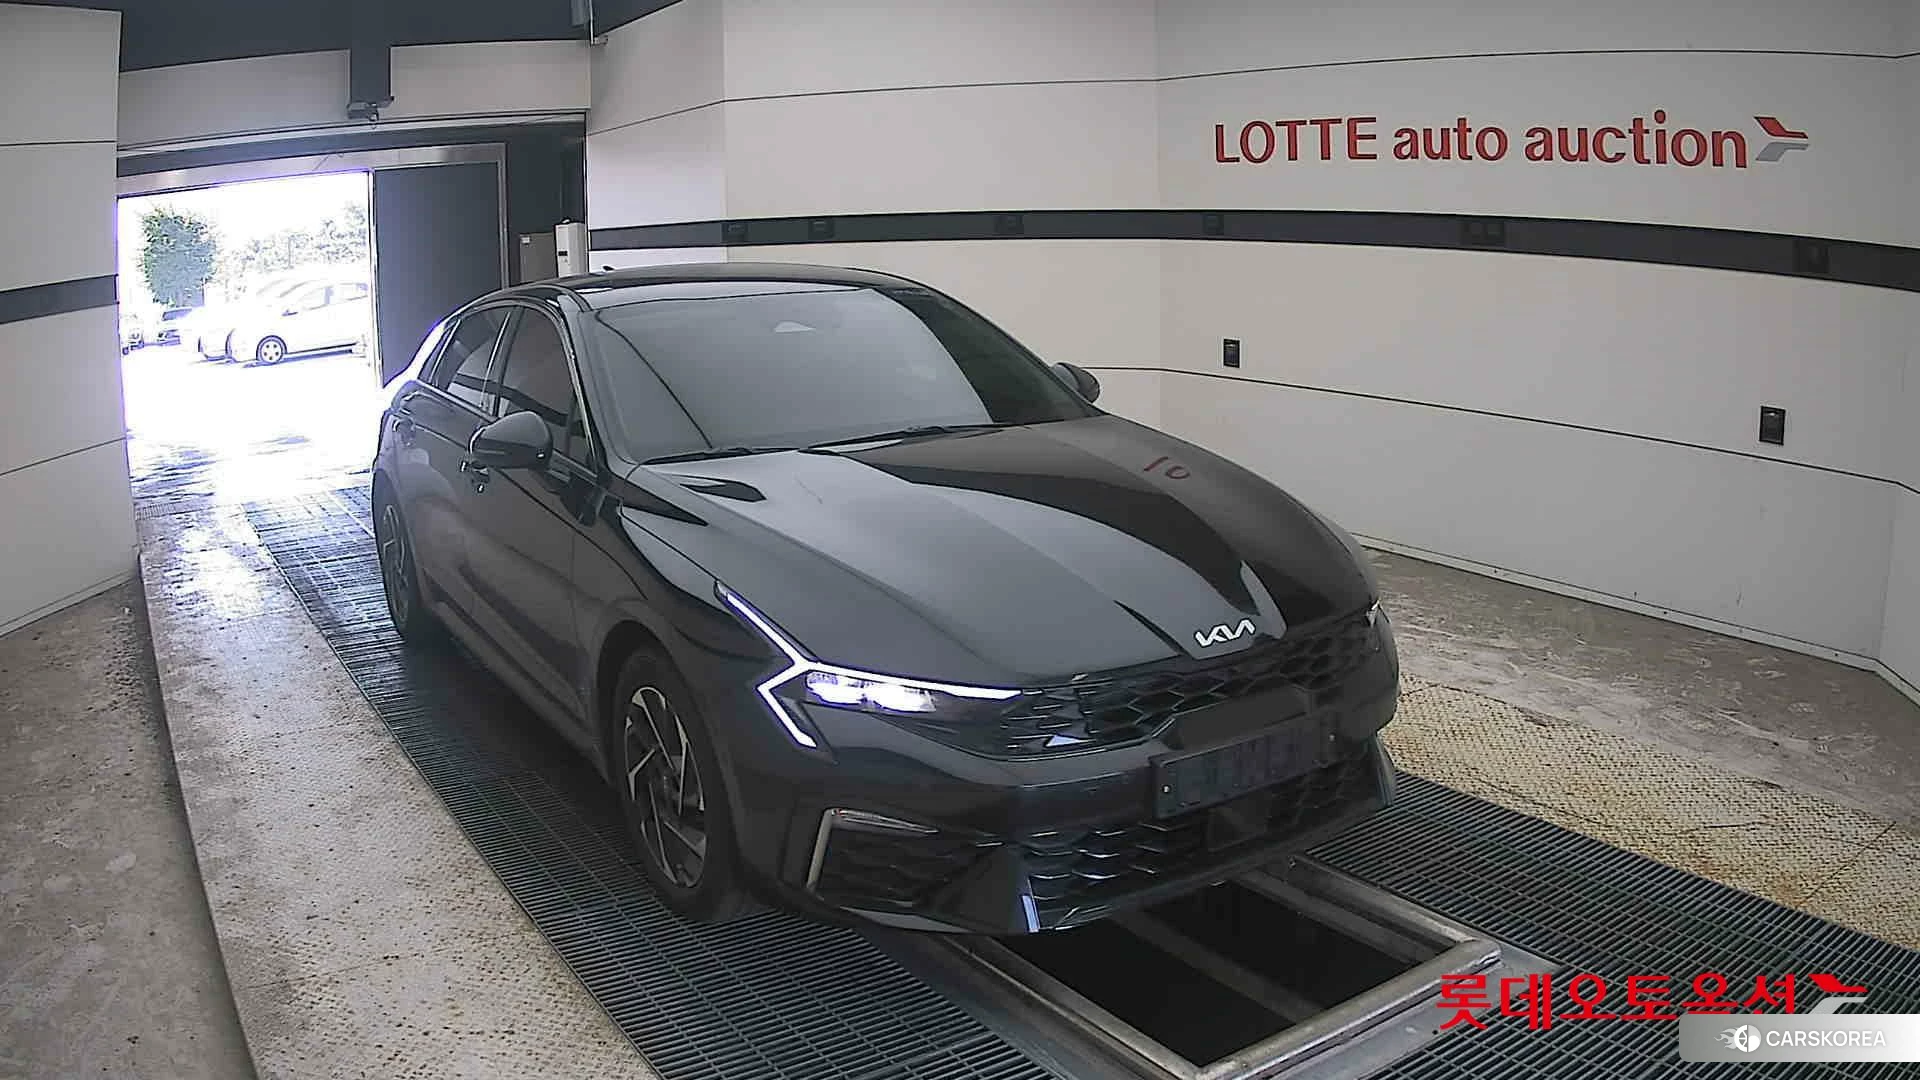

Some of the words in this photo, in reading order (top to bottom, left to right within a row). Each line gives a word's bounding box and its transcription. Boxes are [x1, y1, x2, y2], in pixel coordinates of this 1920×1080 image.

[1215, 116, 1377, 164] LOTTE
[1391, 117, 1510, 162] auto
[1523, 109, 1749, 169] auction
[1195, 619, 1256, 647] KIA
